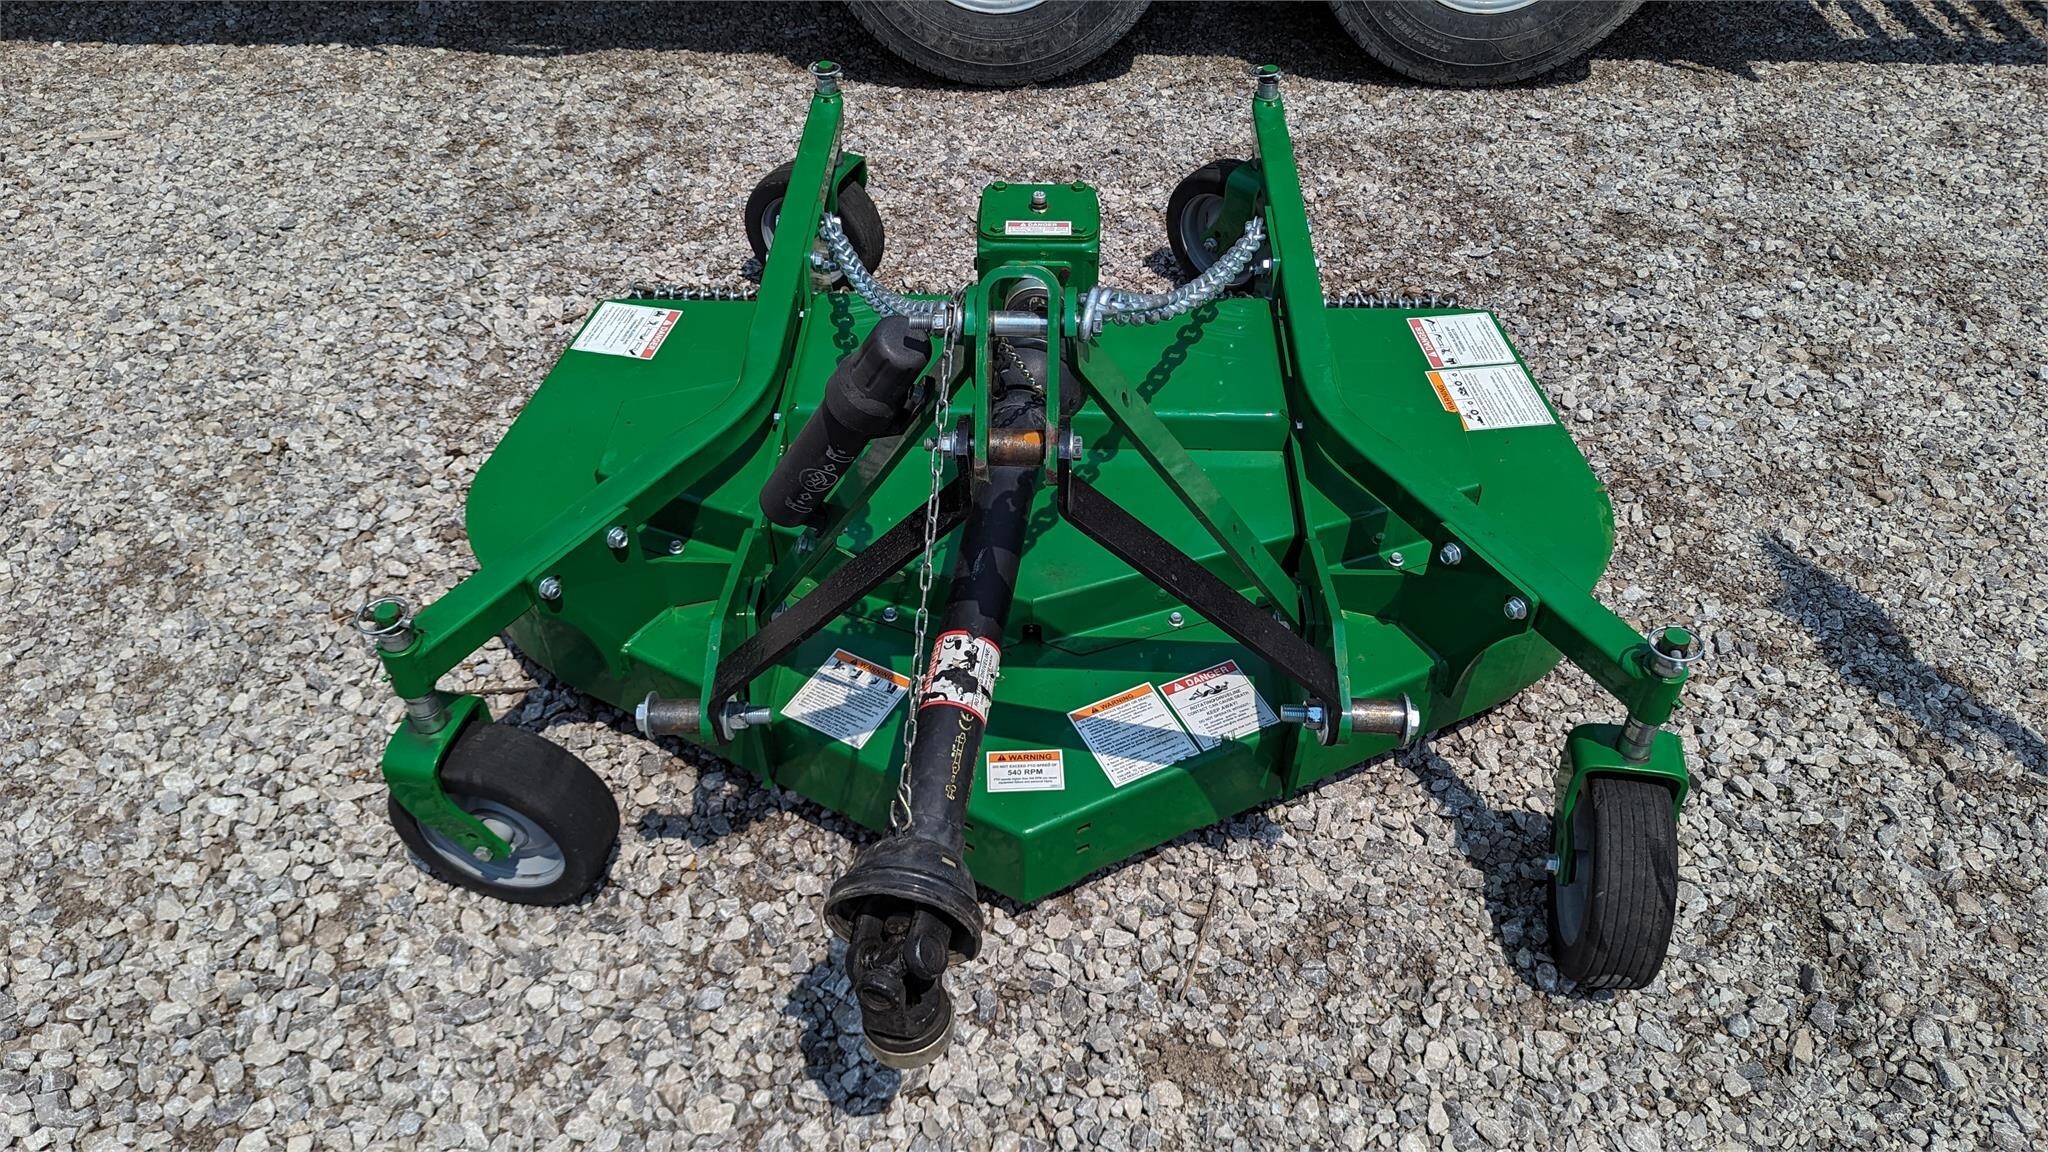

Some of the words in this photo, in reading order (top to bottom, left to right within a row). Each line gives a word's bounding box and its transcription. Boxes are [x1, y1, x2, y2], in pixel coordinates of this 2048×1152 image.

[645, 326, 668, 350] DANGER
[1414, 326, 1433, 350] DANGER
[1437, 384, 1456, 409] WARNING
[858, 661, 895, 680] WARNING
[1183, 665, 1229, 686] DANGER
[1099, 692, 1134, 710] WARNING
[1205, 707, 1221, 715] KEEP
[1186, 706, 1208, 717] CONTACT
